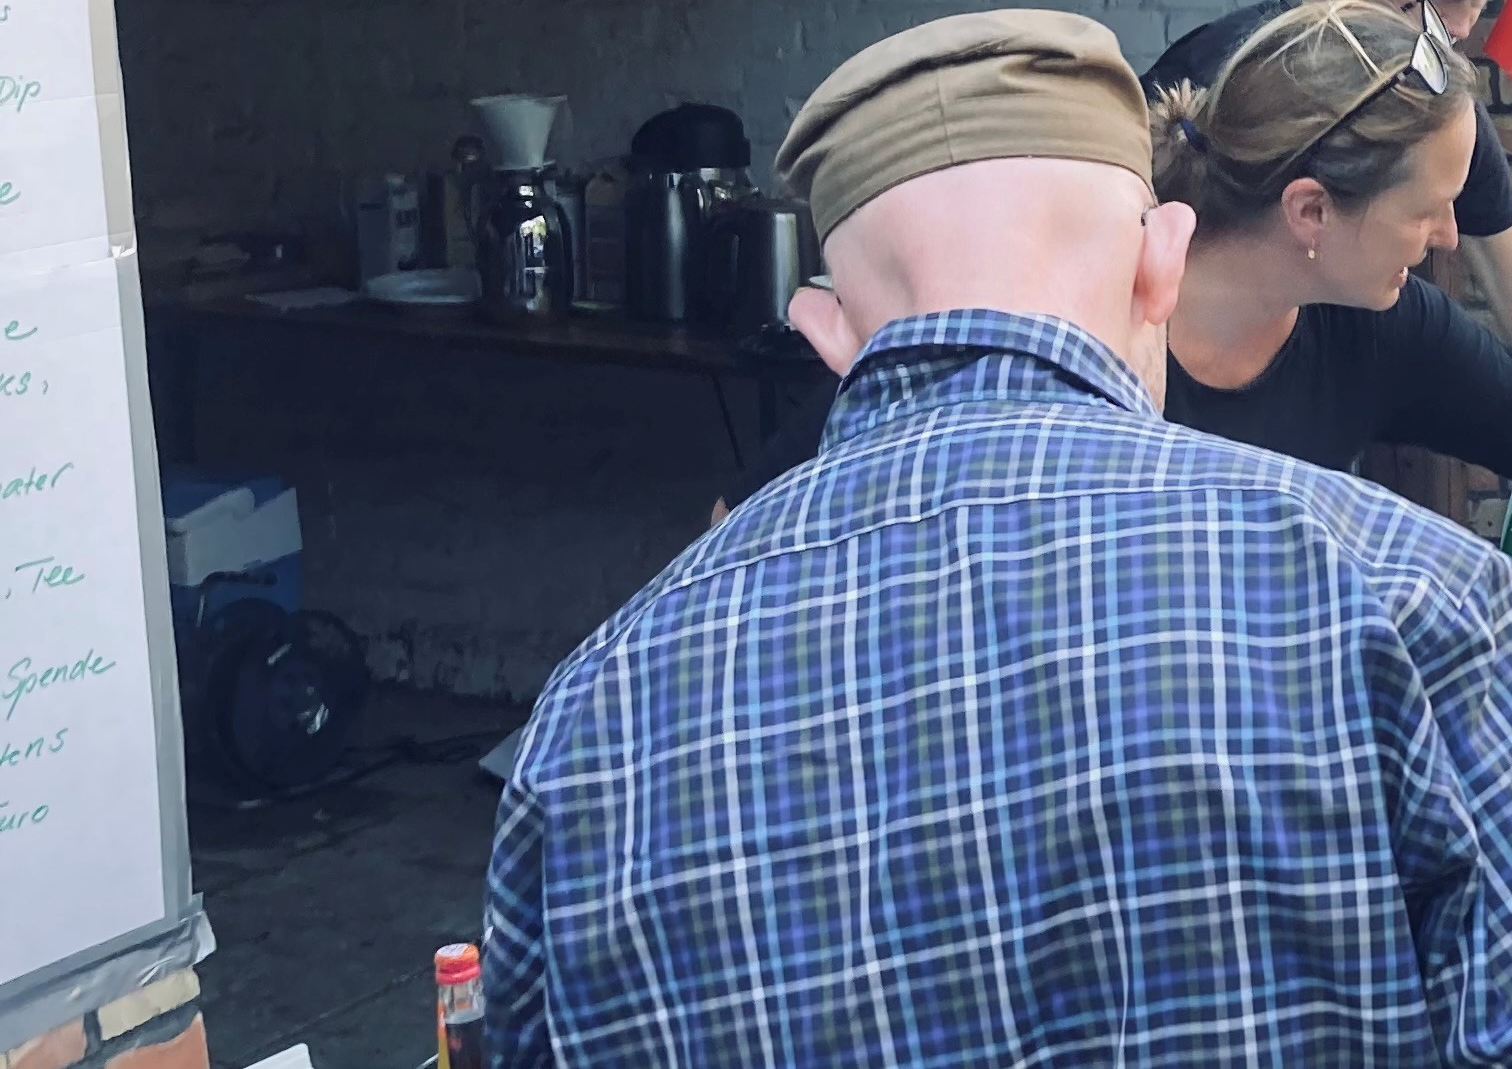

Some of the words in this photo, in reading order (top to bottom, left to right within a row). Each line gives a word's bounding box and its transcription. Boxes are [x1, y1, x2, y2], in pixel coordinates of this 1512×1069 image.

[15, 556, 86, 592] Tee
[2, 648, 116, 721] Spende
[0, 800, 49, 833] uro
